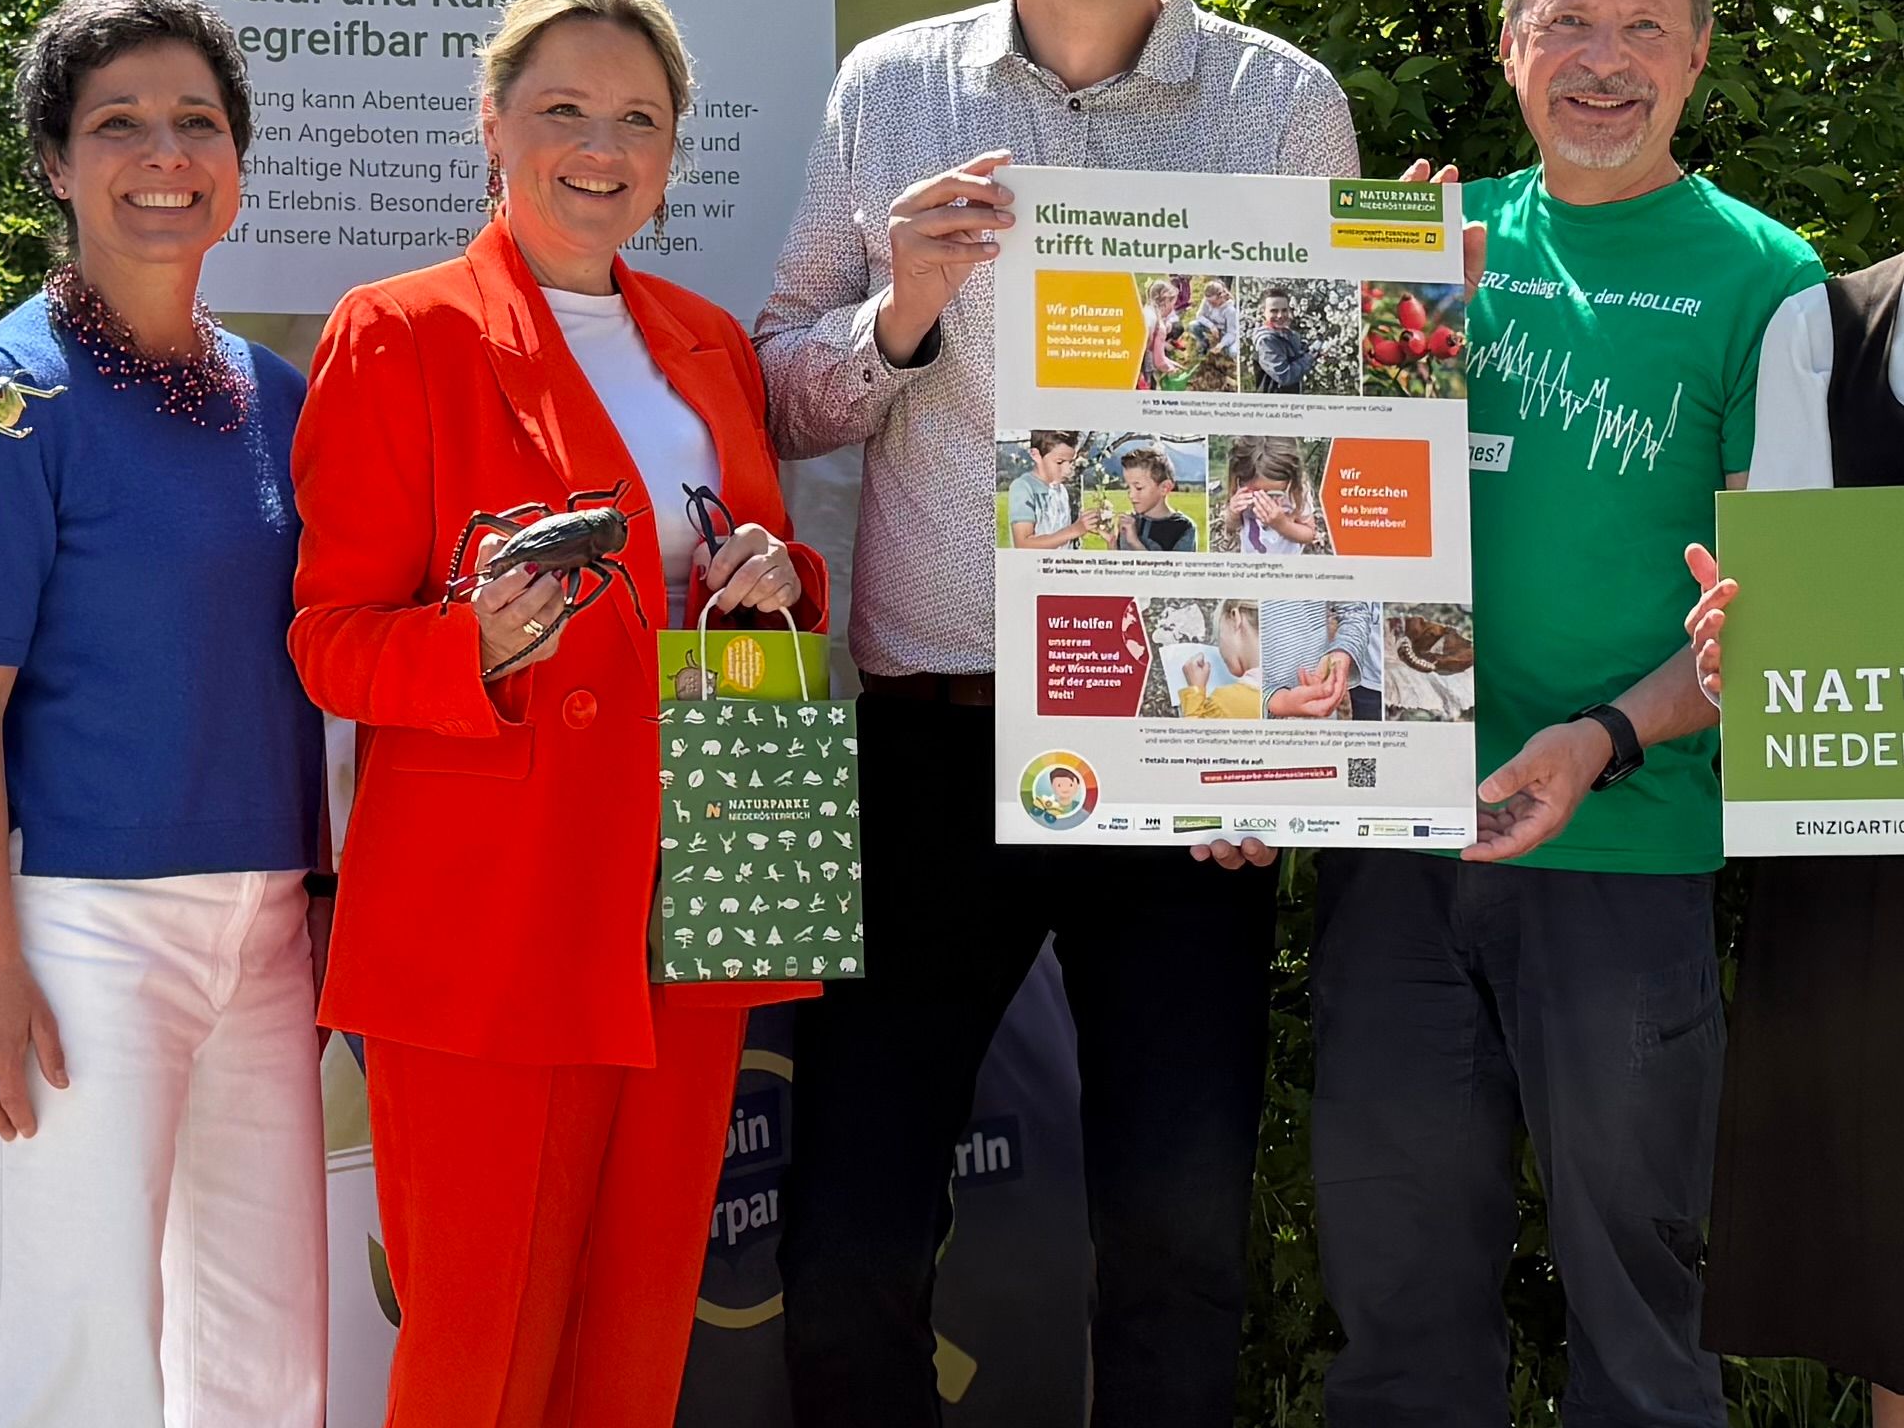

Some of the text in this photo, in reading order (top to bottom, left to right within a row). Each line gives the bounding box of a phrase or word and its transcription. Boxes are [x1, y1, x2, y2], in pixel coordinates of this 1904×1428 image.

[237, 20, 429, 63] egreifbar
[302, 88, 356, 110] kann
[362, 90, 476, 112] Abenteuer
[704, 99, 760, 119] inter-
[298, 123, 419, 148] Angeboten
[701, 132, 741, 152] und
[243, 155, 479, 182] chhaltige Nutzung für
[267, 190, 363, 211] Erlebnis.
[1359, 190, 1436, 202] NATURPARKE
[702, 199, 736, 219] wir
[1034, 202, 1190, 230] Klimawandel
[255, 226, 332, 246] unsere
[1034, 232, 1310, 264] trifft Naturpark-Schule
[1478, 270, 1510, 291] ERZ
[1509, 277, 1565, 300] schlägt
[1594, 288, 1625, 305] den
[1627, 291, 1702, 317] HOLLER!
[1045, 303, 1124, 318] Wir pflanzen
[1339, 467, 1362, 481] Wir
[1339, 484, 1409, 499] erforschen
[1047, 616, 1114, 630] Wir helfen
[1047, 663, 1134, 675] der Wissenschaft
[1066, 676, 1084, 687] der
[728, 798, 811, 810] NATURPARKE
[1233, 818, 1277, 828] LACON
